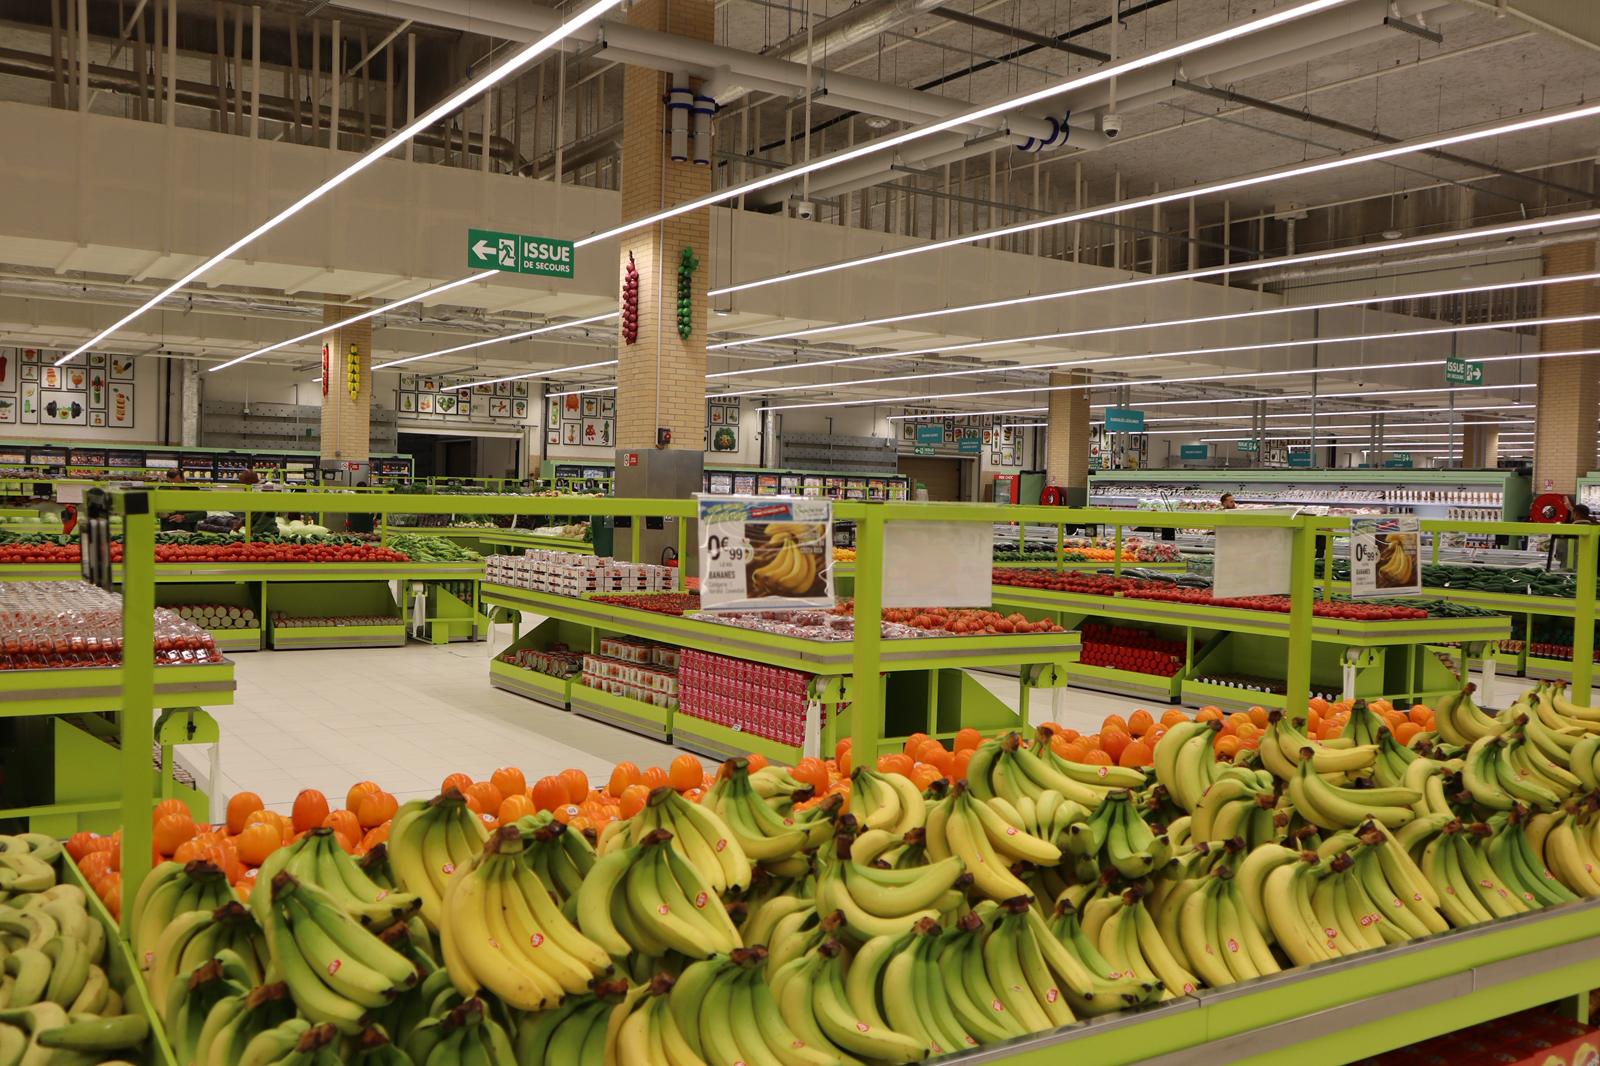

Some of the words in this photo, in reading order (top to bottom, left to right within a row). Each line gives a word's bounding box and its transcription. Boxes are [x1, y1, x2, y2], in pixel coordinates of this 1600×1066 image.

[524, 242, 570, 262] ISSUE
[524, 260, 534, 269] DE
[536, 262, 570, 272] SECOURS
[1448, 362, 1464, 373] ISSUE
[708, 570, 736, 579] BANANES
